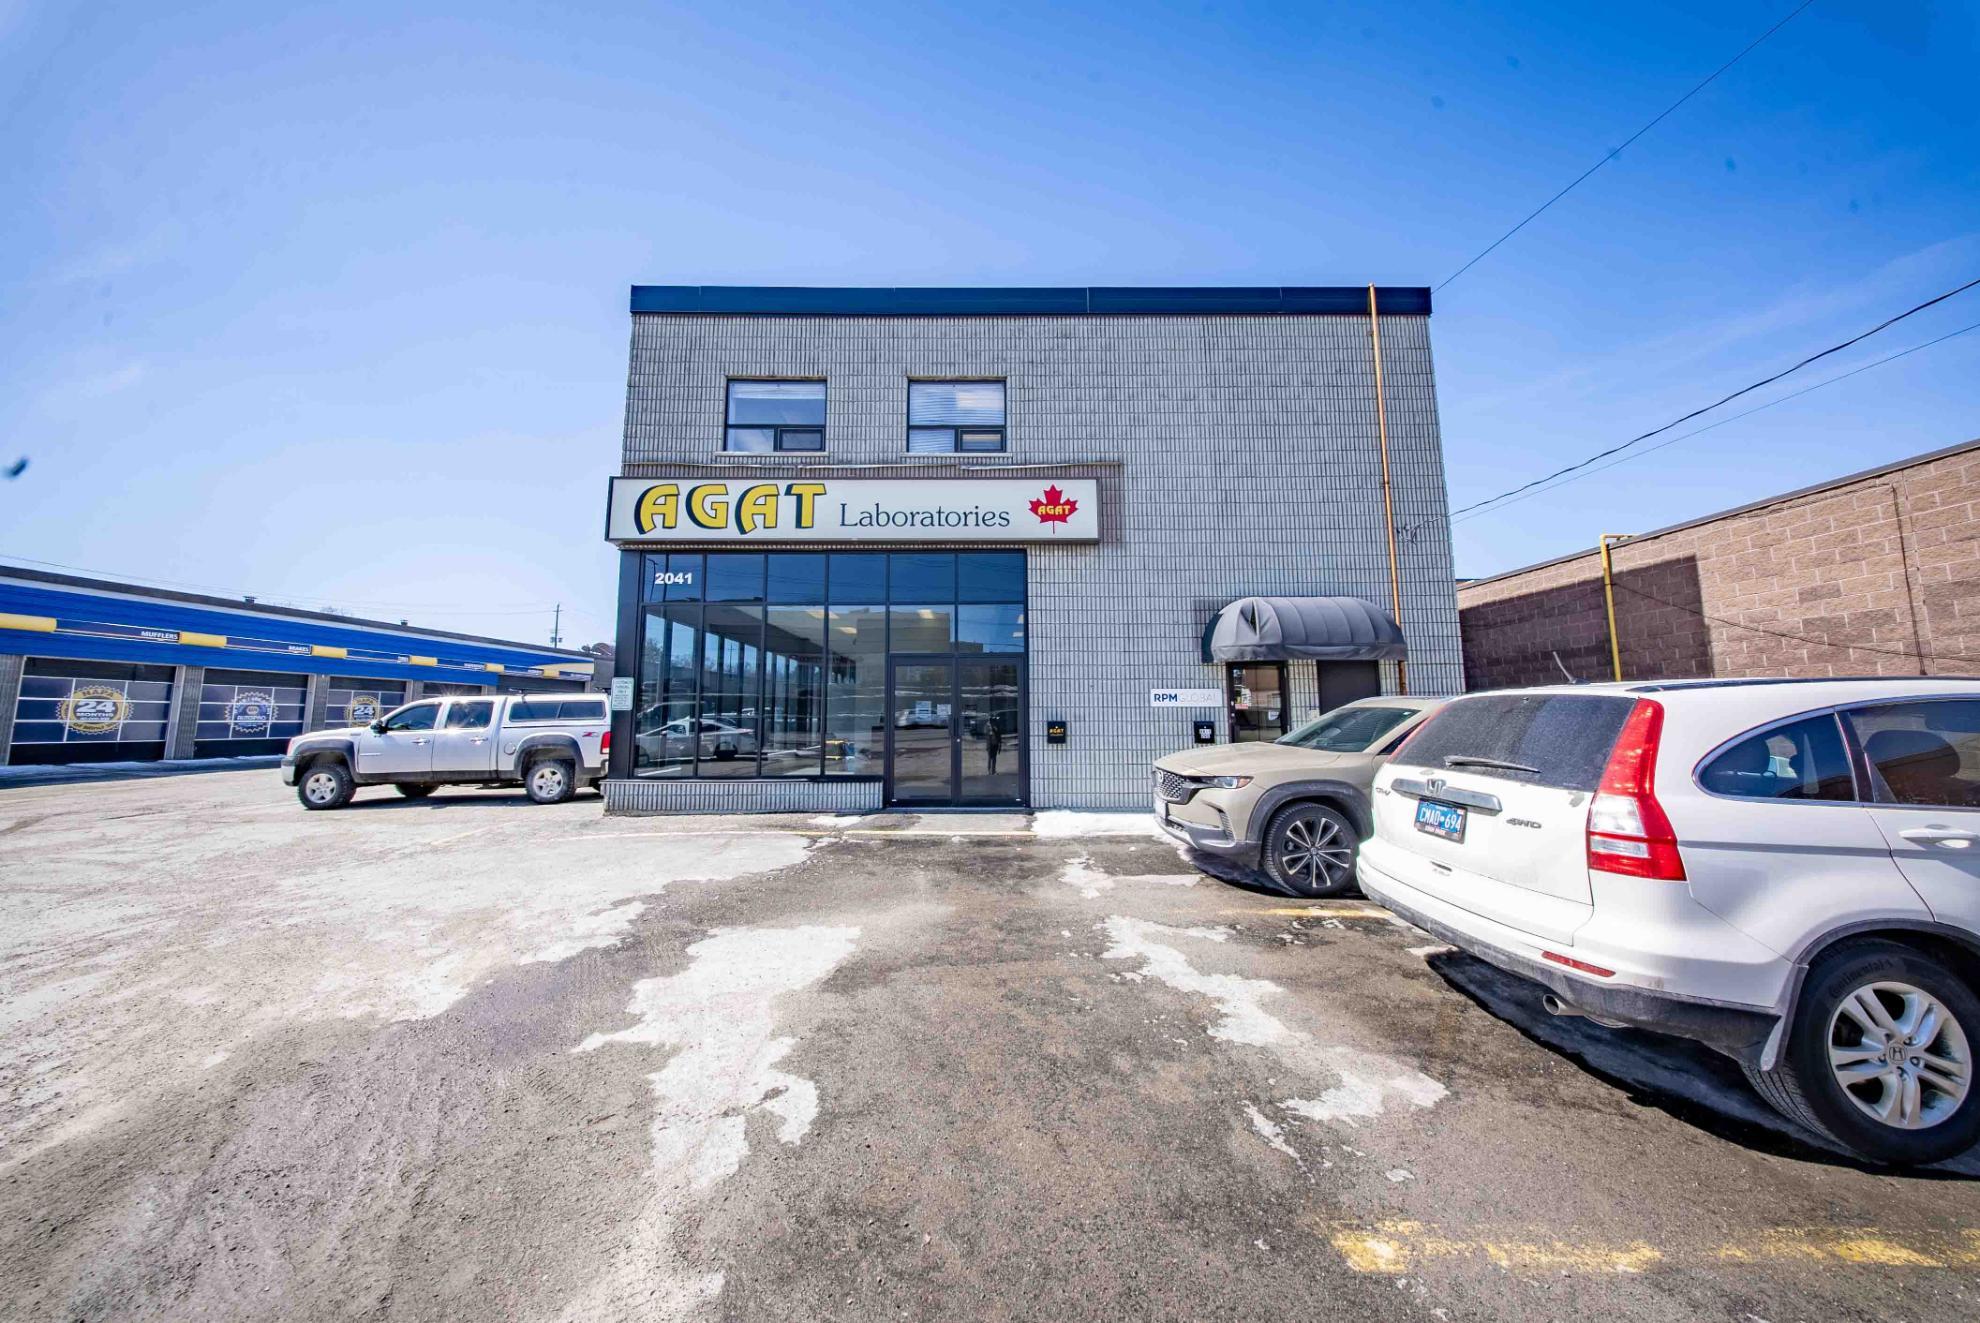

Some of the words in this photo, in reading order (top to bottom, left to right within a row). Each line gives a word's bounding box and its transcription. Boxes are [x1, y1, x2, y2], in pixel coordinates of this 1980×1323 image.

[634, 483, 827, 535] AGAT
[839, 502, 1011, 527] Laboratories
[1037, 505, 1071, 515] AGAT
[655, 572, 692, 584] 2041
[141, 630, 178, 640] MUFFLERS
[76, 701, 115, 713] 24
[1444, 812, 1462, 832] 694
